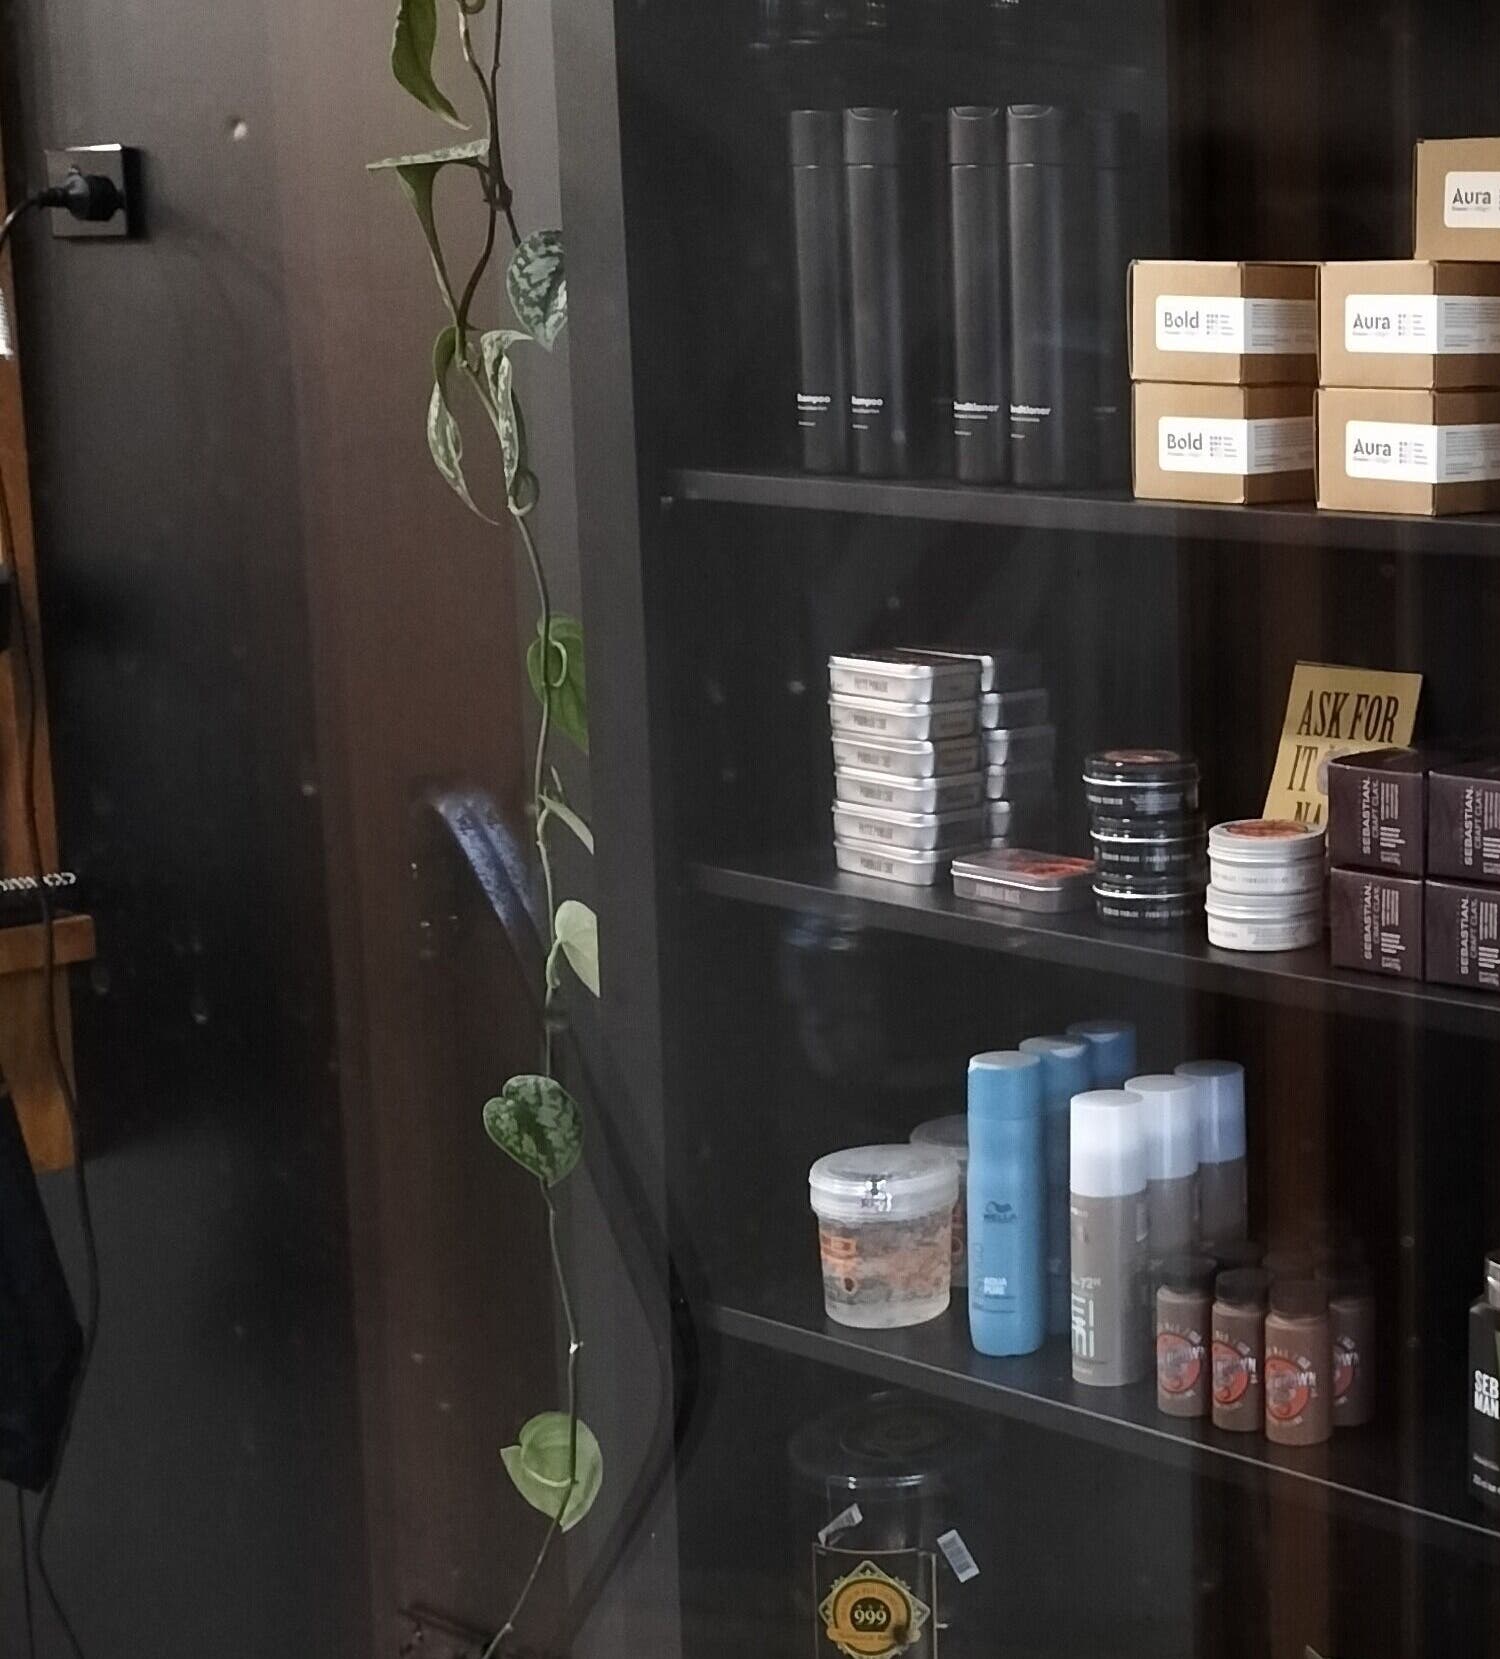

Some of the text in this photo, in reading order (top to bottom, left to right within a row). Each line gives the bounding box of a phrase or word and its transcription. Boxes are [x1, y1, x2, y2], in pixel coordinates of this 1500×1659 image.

[1452, 187, 1492, 206] Aura
[1164, 310, 1200, 329] Bold
[1353, 314, 1391, 331] Aura
[1167, 433, 1203, 452] Bold
[1353, 438, 1392, 457] Aura
[1297, 690, 1399, 744] ASK FOR
[1287, 744, 1319, 793] IT
[1294, 801, 1322, 825] NA
[1474, 1370, 1500, 1400] SEB
[853, 1609, 888, 1626] 999
